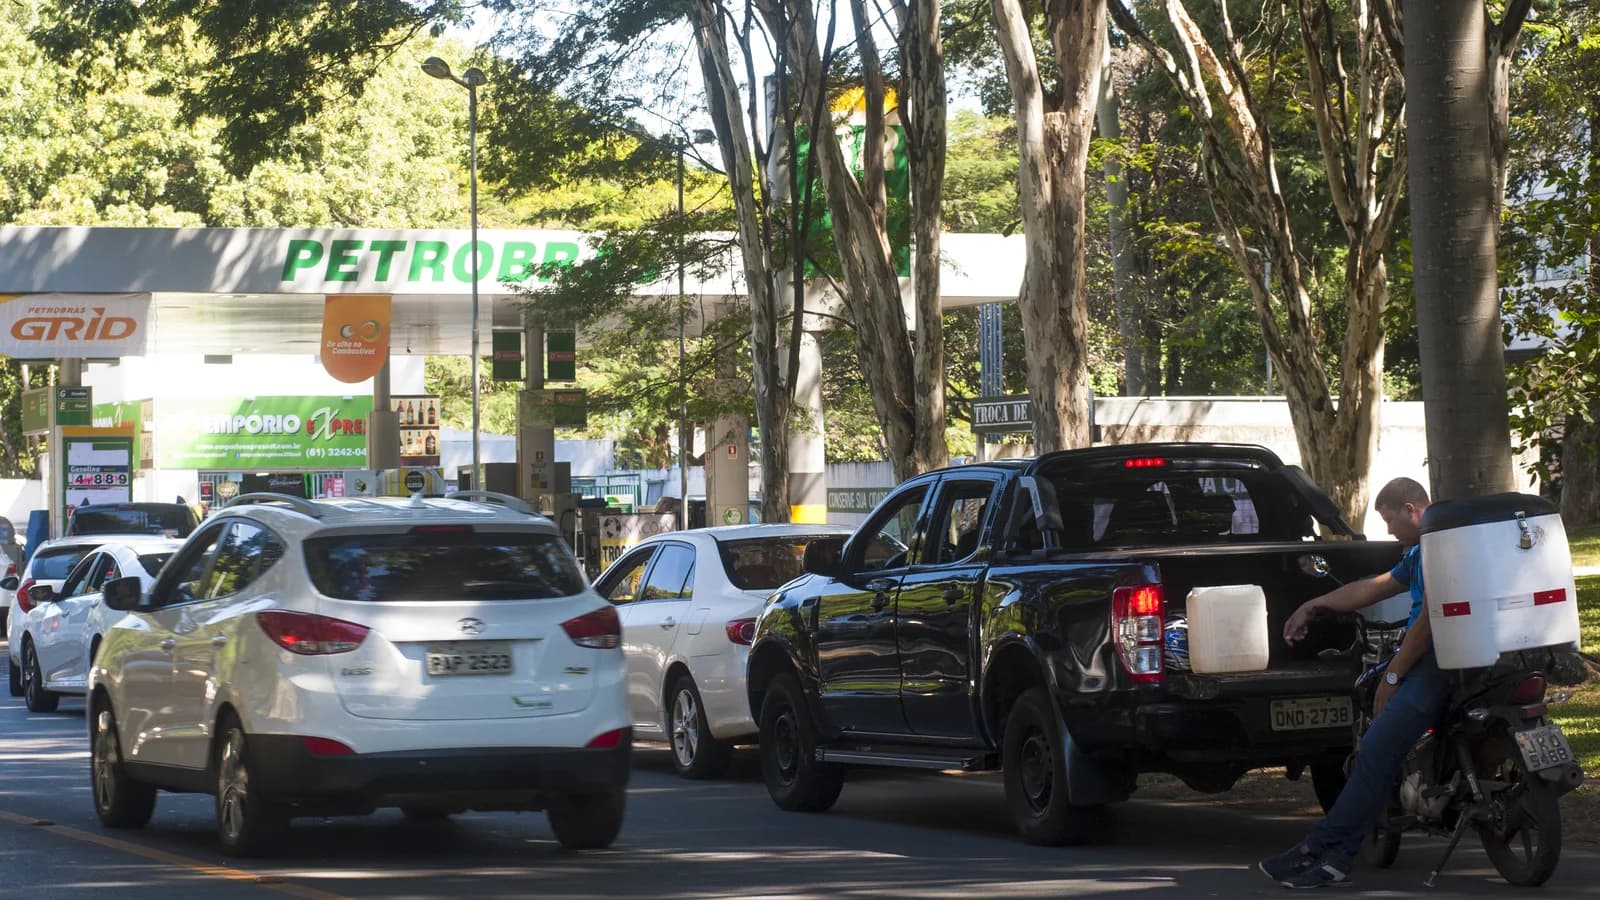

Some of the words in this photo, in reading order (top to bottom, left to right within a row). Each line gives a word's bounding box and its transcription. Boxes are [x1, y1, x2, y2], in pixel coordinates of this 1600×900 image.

[281, 239, 657, 283] PETROBR
[28, 306, 86, 314] PETROBRAS
[10, 307, 138, 340] GRID
[974, 405, 1008, 423] TROCA
[1013, 404, 1028, 420] DE
[306, 447, 325, 458] (61)
[828, 492, 855, 508] CONSERVE
[856, 492, 867, 509] SUA
